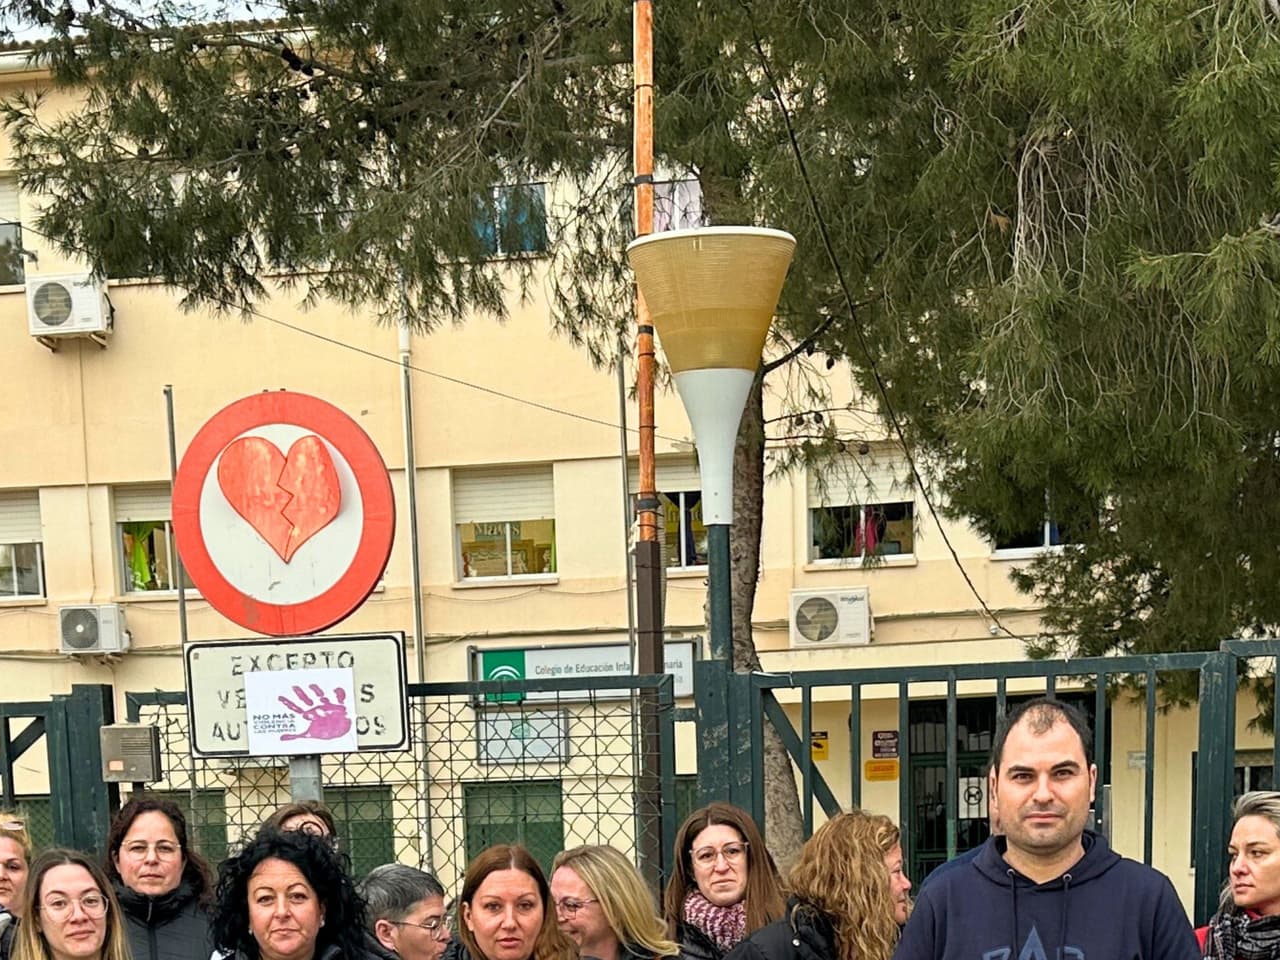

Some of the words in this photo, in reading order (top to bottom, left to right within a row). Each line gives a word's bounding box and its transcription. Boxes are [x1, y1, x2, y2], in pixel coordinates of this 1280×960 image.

[535, 665, 562, 676] Colegio
[564, 664, 573, 673] de
[576, 662, 614, 673] Educación
[616, 661, 631, 672] Infa
